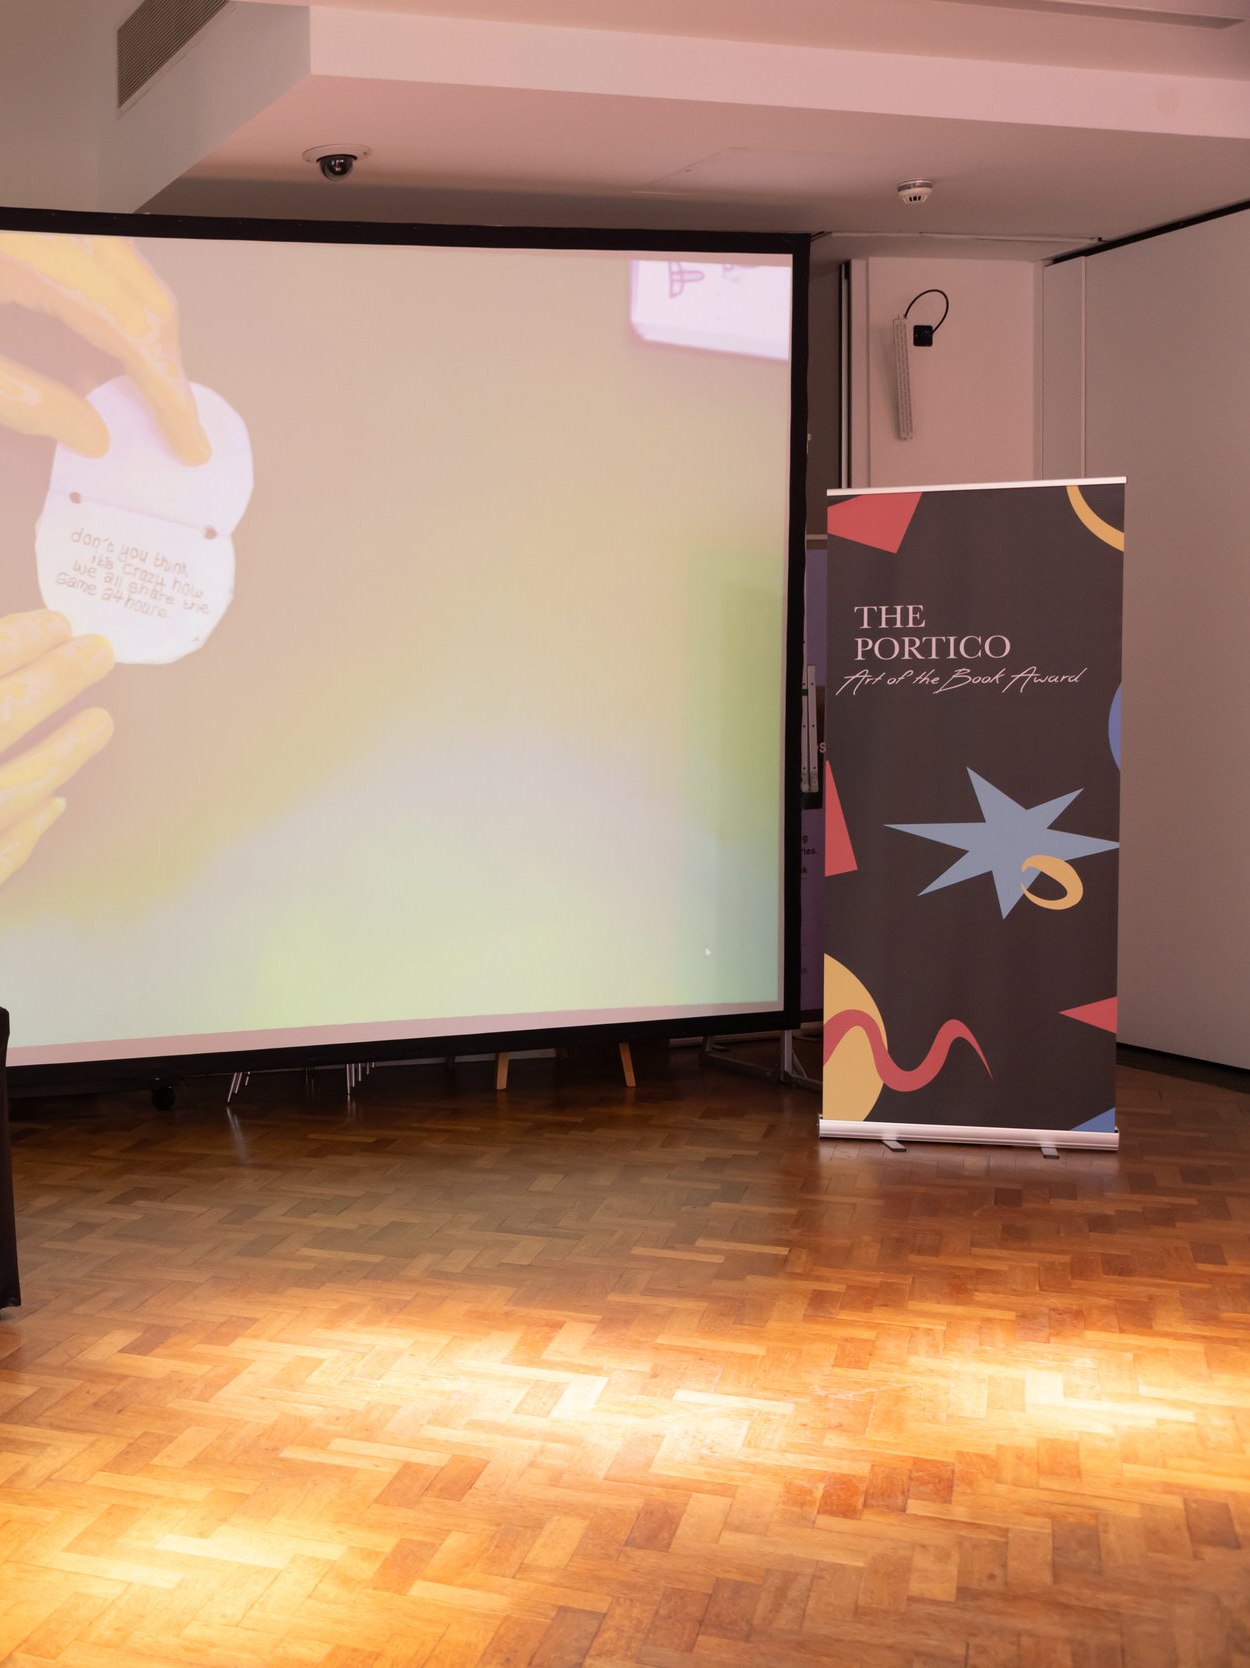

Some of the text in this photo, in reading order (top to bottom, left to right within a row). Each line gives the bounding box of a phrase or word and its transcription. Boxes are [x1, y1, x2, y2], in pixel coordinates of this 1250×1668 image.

[71, 528, 114, 552] don't
[118, 544, 149, 563] you
[73, 561, 210, 615] we all share the
[101, 588, 123, 604] 24
[172, 580, 204, 600] how
[854, 604, 926, 629] THE
[854, 635, 1011, 661] PORTICO
[836, 665, 1088, 696] Art of the Book Award
